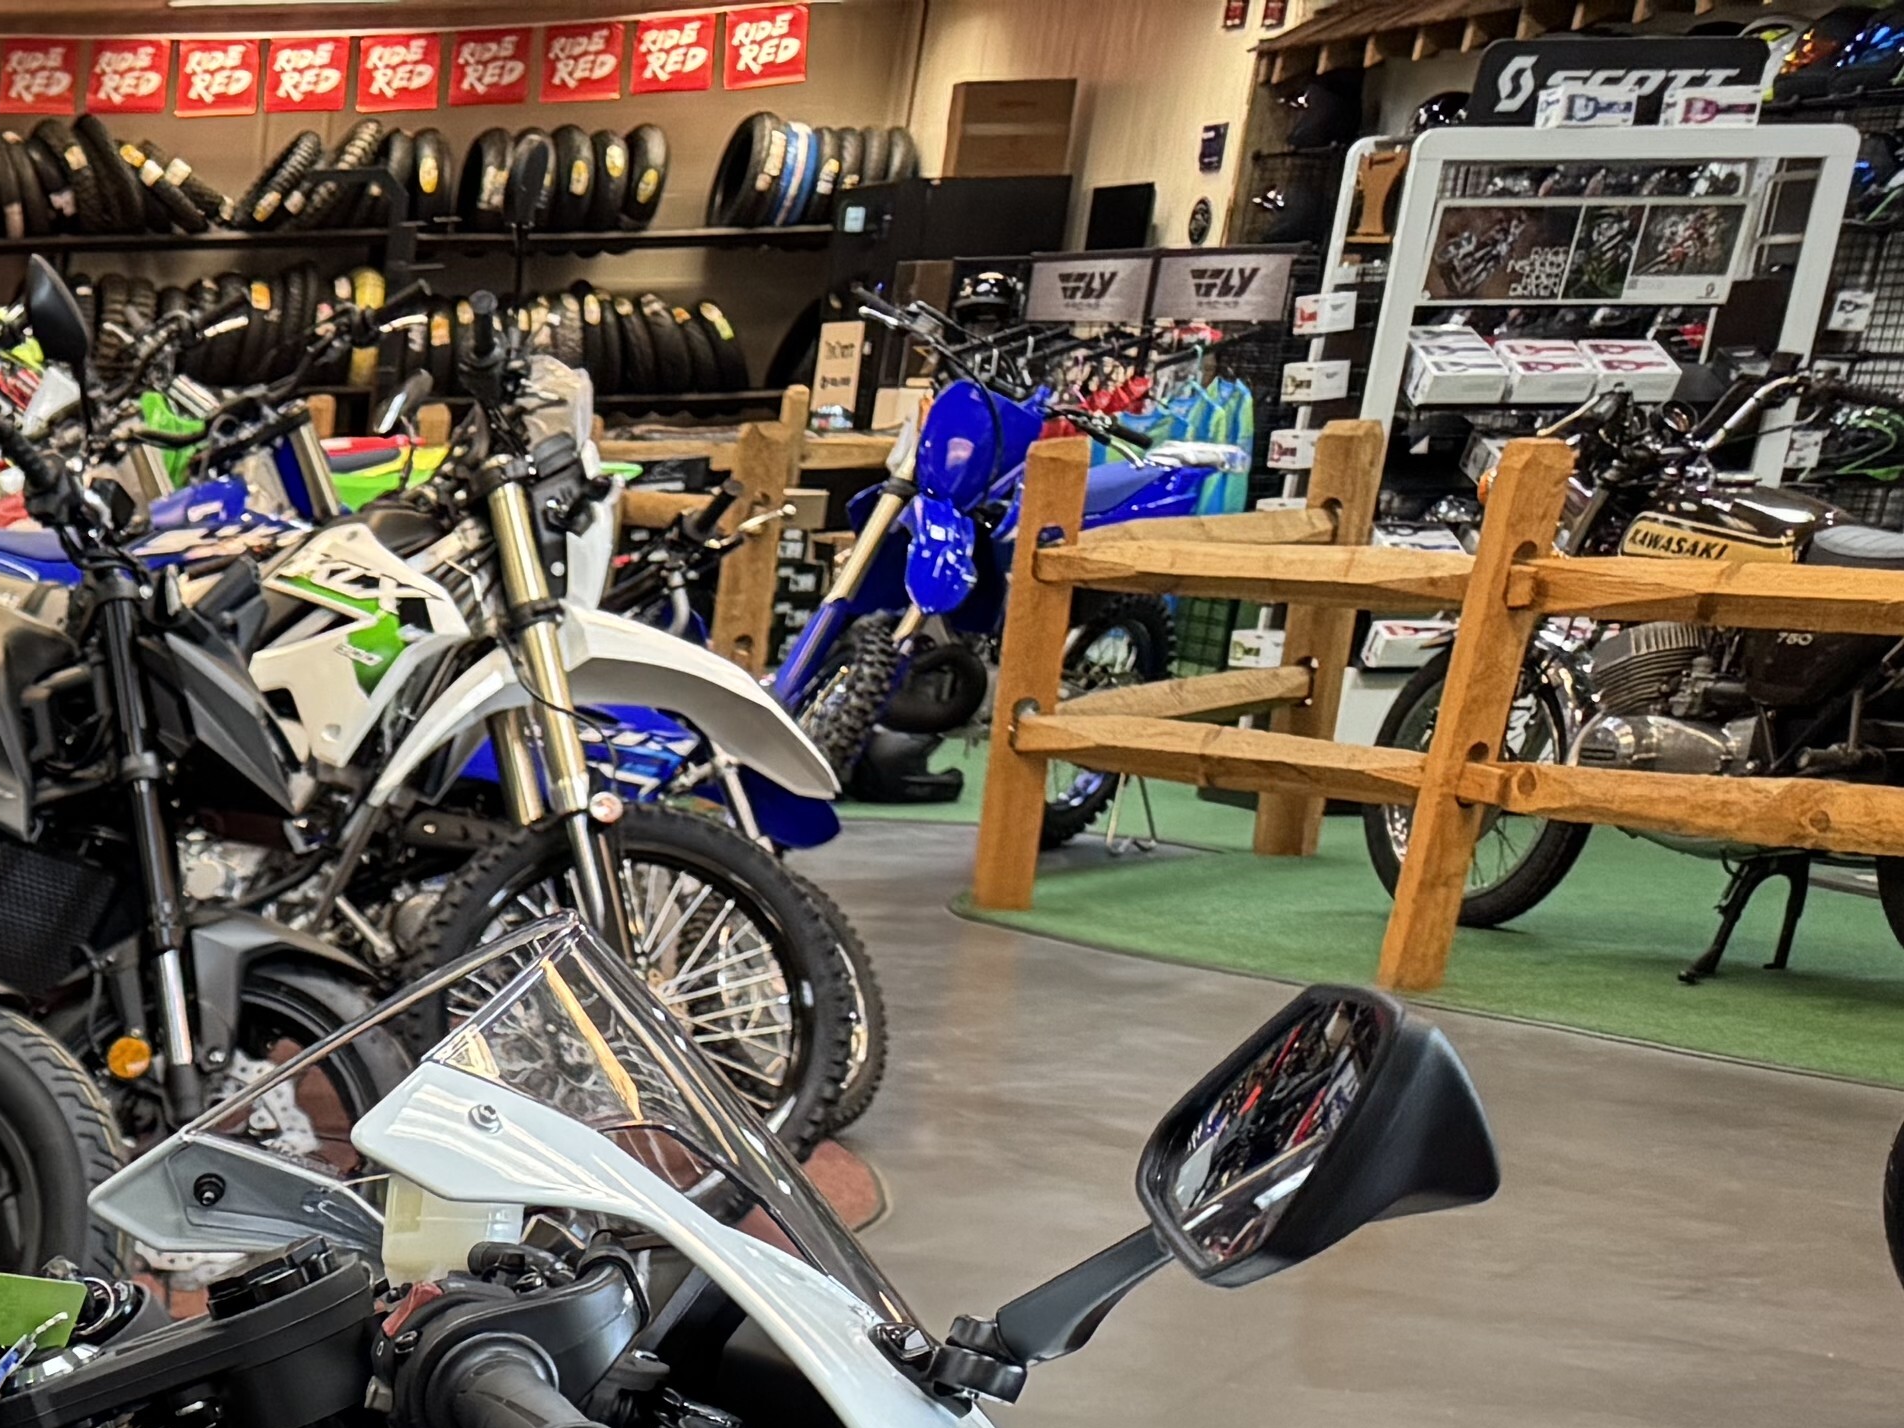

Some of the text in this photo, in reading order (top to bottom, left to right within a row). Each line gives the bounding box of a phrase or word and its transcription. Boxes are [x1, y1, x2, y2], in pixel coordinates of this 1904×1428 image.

[549, 28, 610, 60] RIDE
[640, 20, 702, 53] RIDE
[731, 12, 793, 46] RIDE
[7, 48, 66, 72] RIDE
[95, 46, 156, 74] RIDE
[185, 44, 247, 74] RIDE
[274, 41, 335, 72] RIDE
[365, 38, 427, 69] RIDE
[457, 36, 519, 65] RIDE
[642, 47, 708, 82] RED
[735, 37, 801, 75] RED
[9, 70, 72, 103] RED
[187, 69, 253, 103] RED
[277, 67, 341, 102] RED
[369, 64, 434, 98] RED
[460, 60, 525, 95] RED
[551, 53, 617, 88] RED
[1545, 68, 1741, 96] SCOTT
[97, 70, 162, 105] RED
[1191, 267, 1260, 298] FLY
[1628, 528, 1729, 560] KAWASAKI
